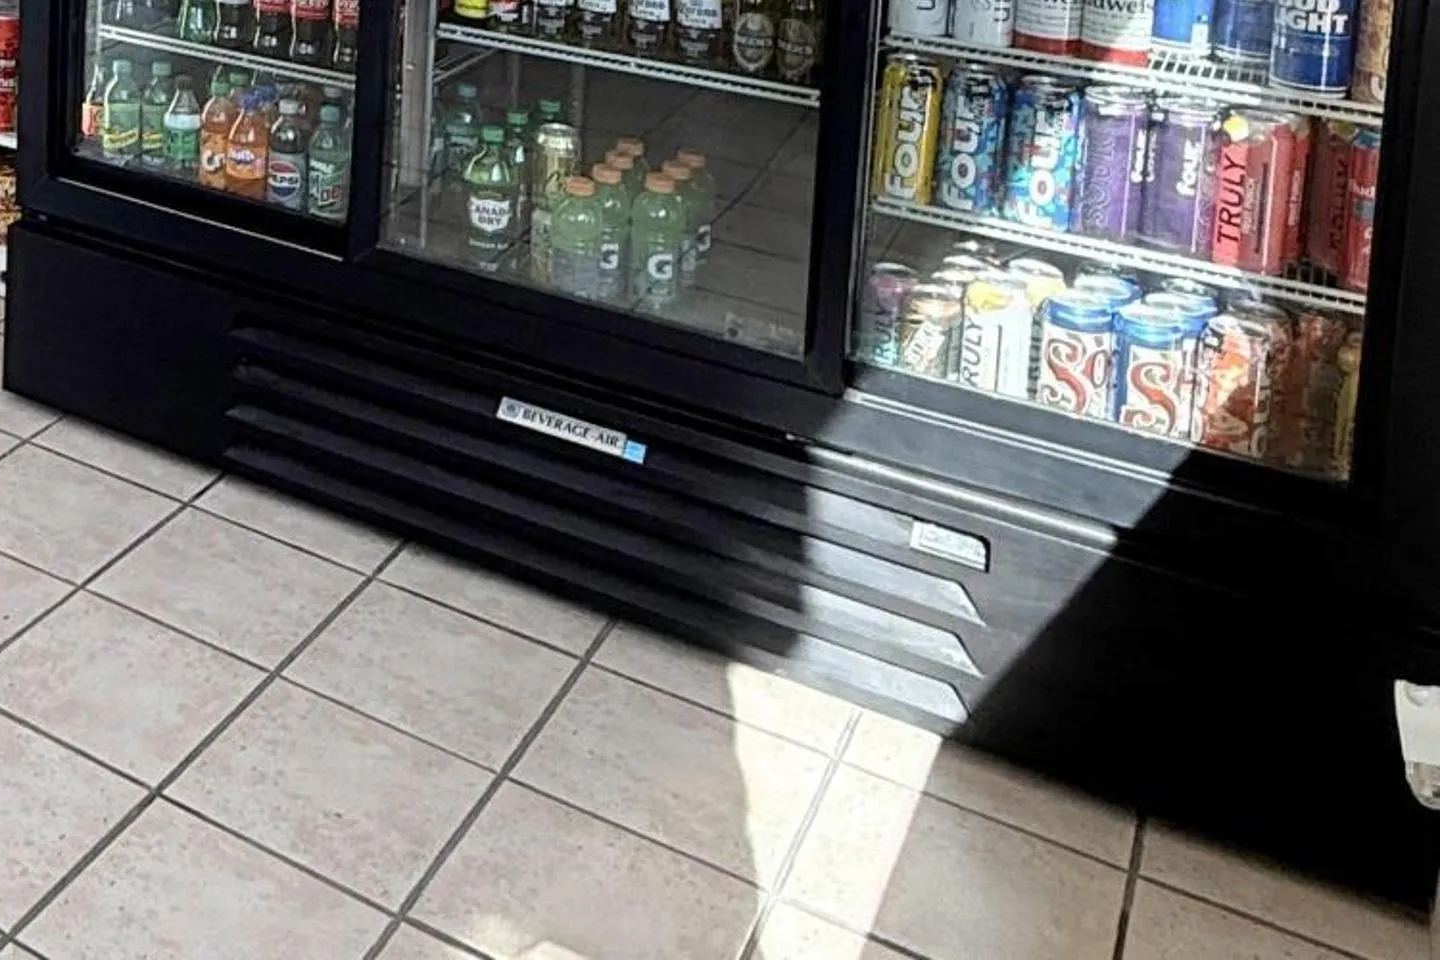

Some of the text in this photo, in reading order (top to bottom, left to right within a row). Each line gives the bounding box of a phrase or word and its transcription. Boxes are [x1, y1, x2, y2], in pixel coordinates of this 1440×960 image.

[269, 172, 300, 188] PEPSI
[1216, 153, 1246, 244] TRULY
[474, 204, 509, 217] ANAD
[647, 252, 673, 280] G
[872, 304, 895, 364] RULY
[962, 315, 984, 388] RULY
